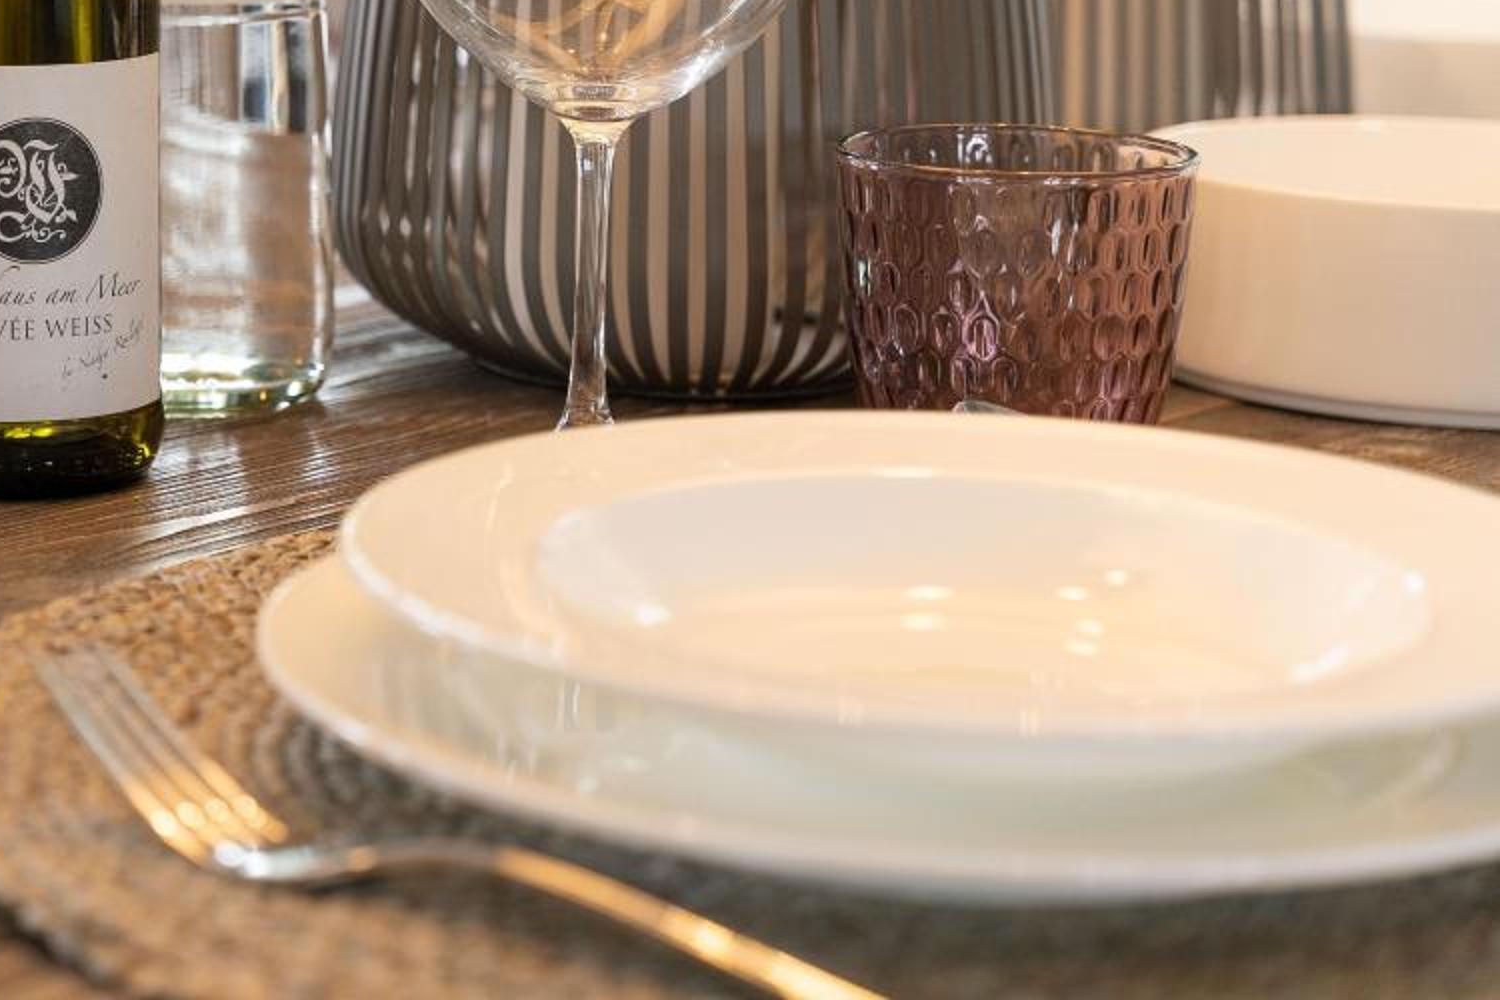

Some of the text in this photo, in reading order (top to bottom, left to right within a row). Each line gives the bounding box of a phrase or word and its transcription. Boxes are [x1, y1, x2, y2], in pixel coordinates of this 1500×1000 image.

[45, 287, 77, 305] am
[85, 271, 141, 303] Meer
[45, 312, 113, 338] WEISS
